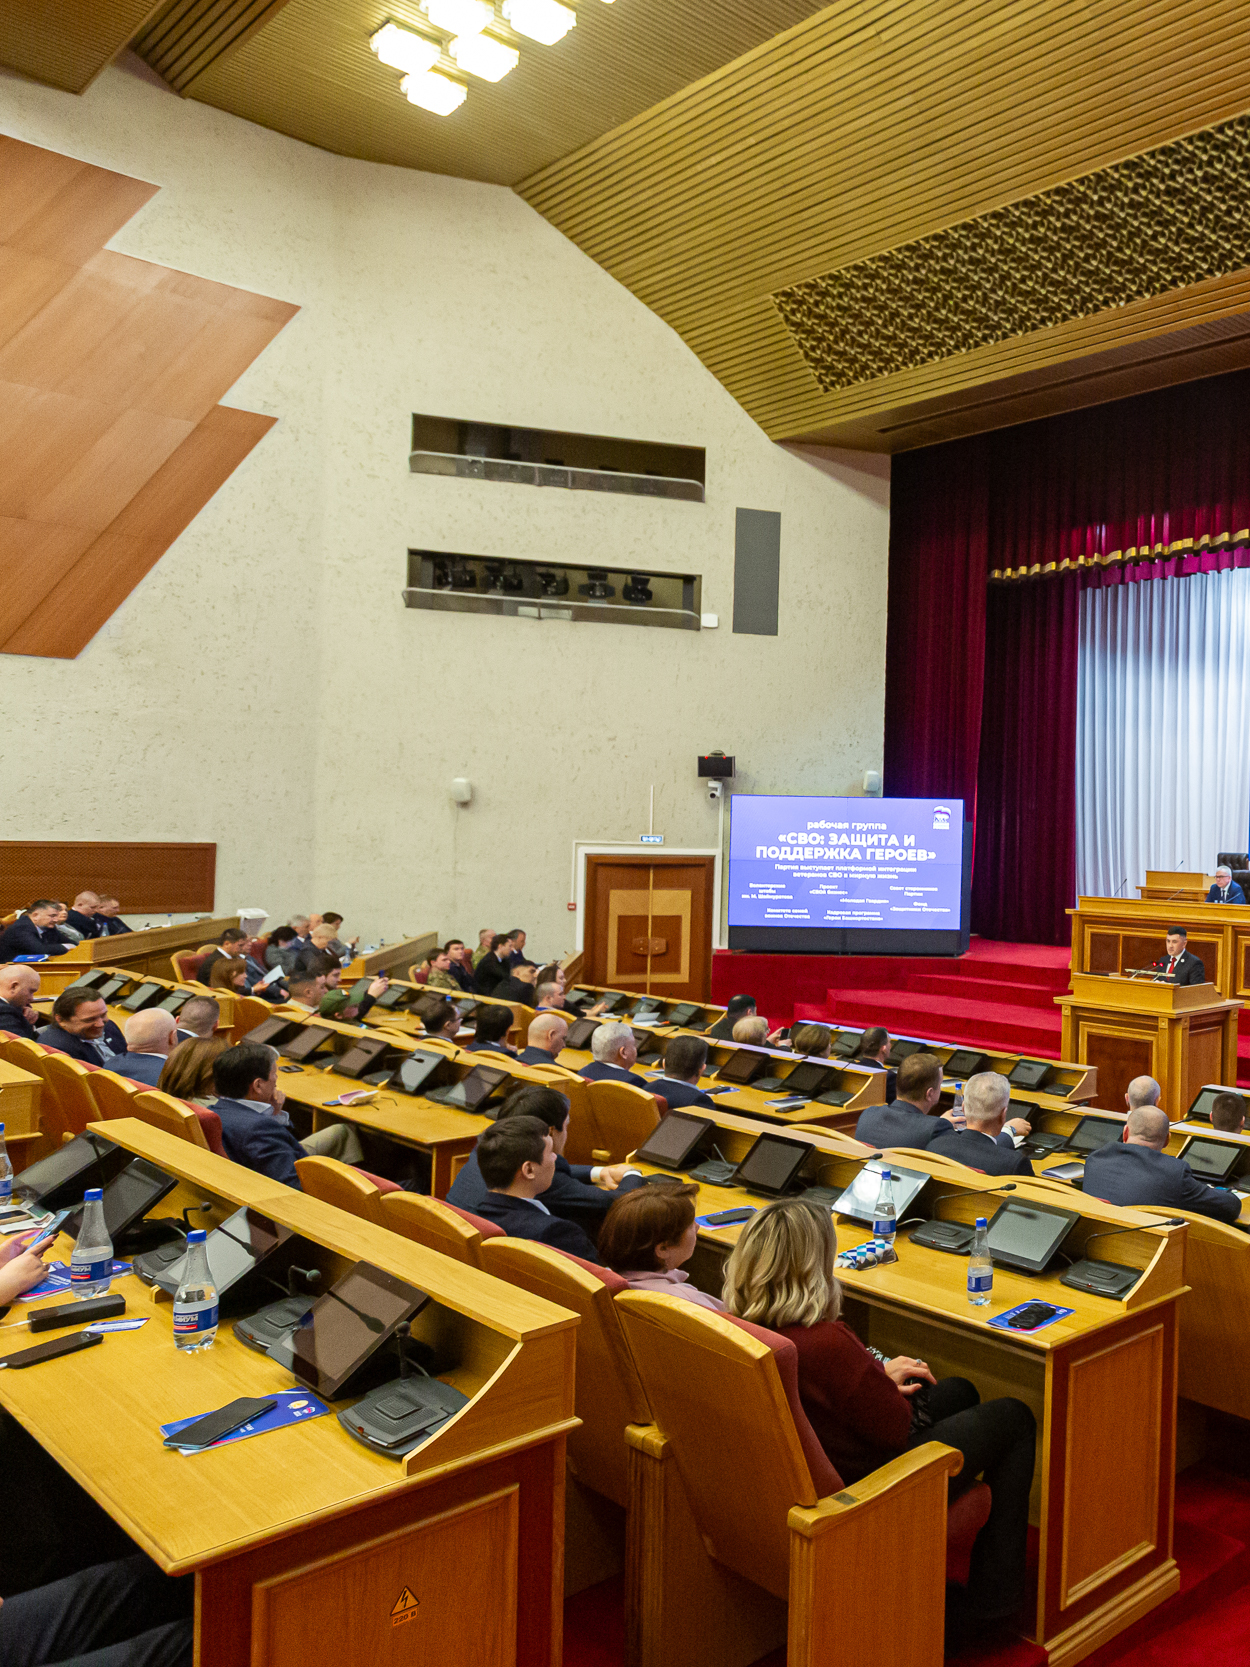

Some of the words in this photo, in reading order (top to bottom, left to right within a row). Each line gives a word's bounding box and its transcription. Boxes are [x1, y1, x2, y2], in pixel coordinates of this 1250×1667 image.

[807, 820, 849, 830] рабочая
[852, 821, 887, 831] группа
[778, 833, 825, 845] «СВО:
[829, 833, 899, 847] ЗАЩИТА
[904, 835, 915, 846] И
[756, 846, 861, 861] ПОДДЕРЖКА
[867, 849, 936, 861] ГЕРОЕВ»
[394, 1614, 408, 1624] 220
